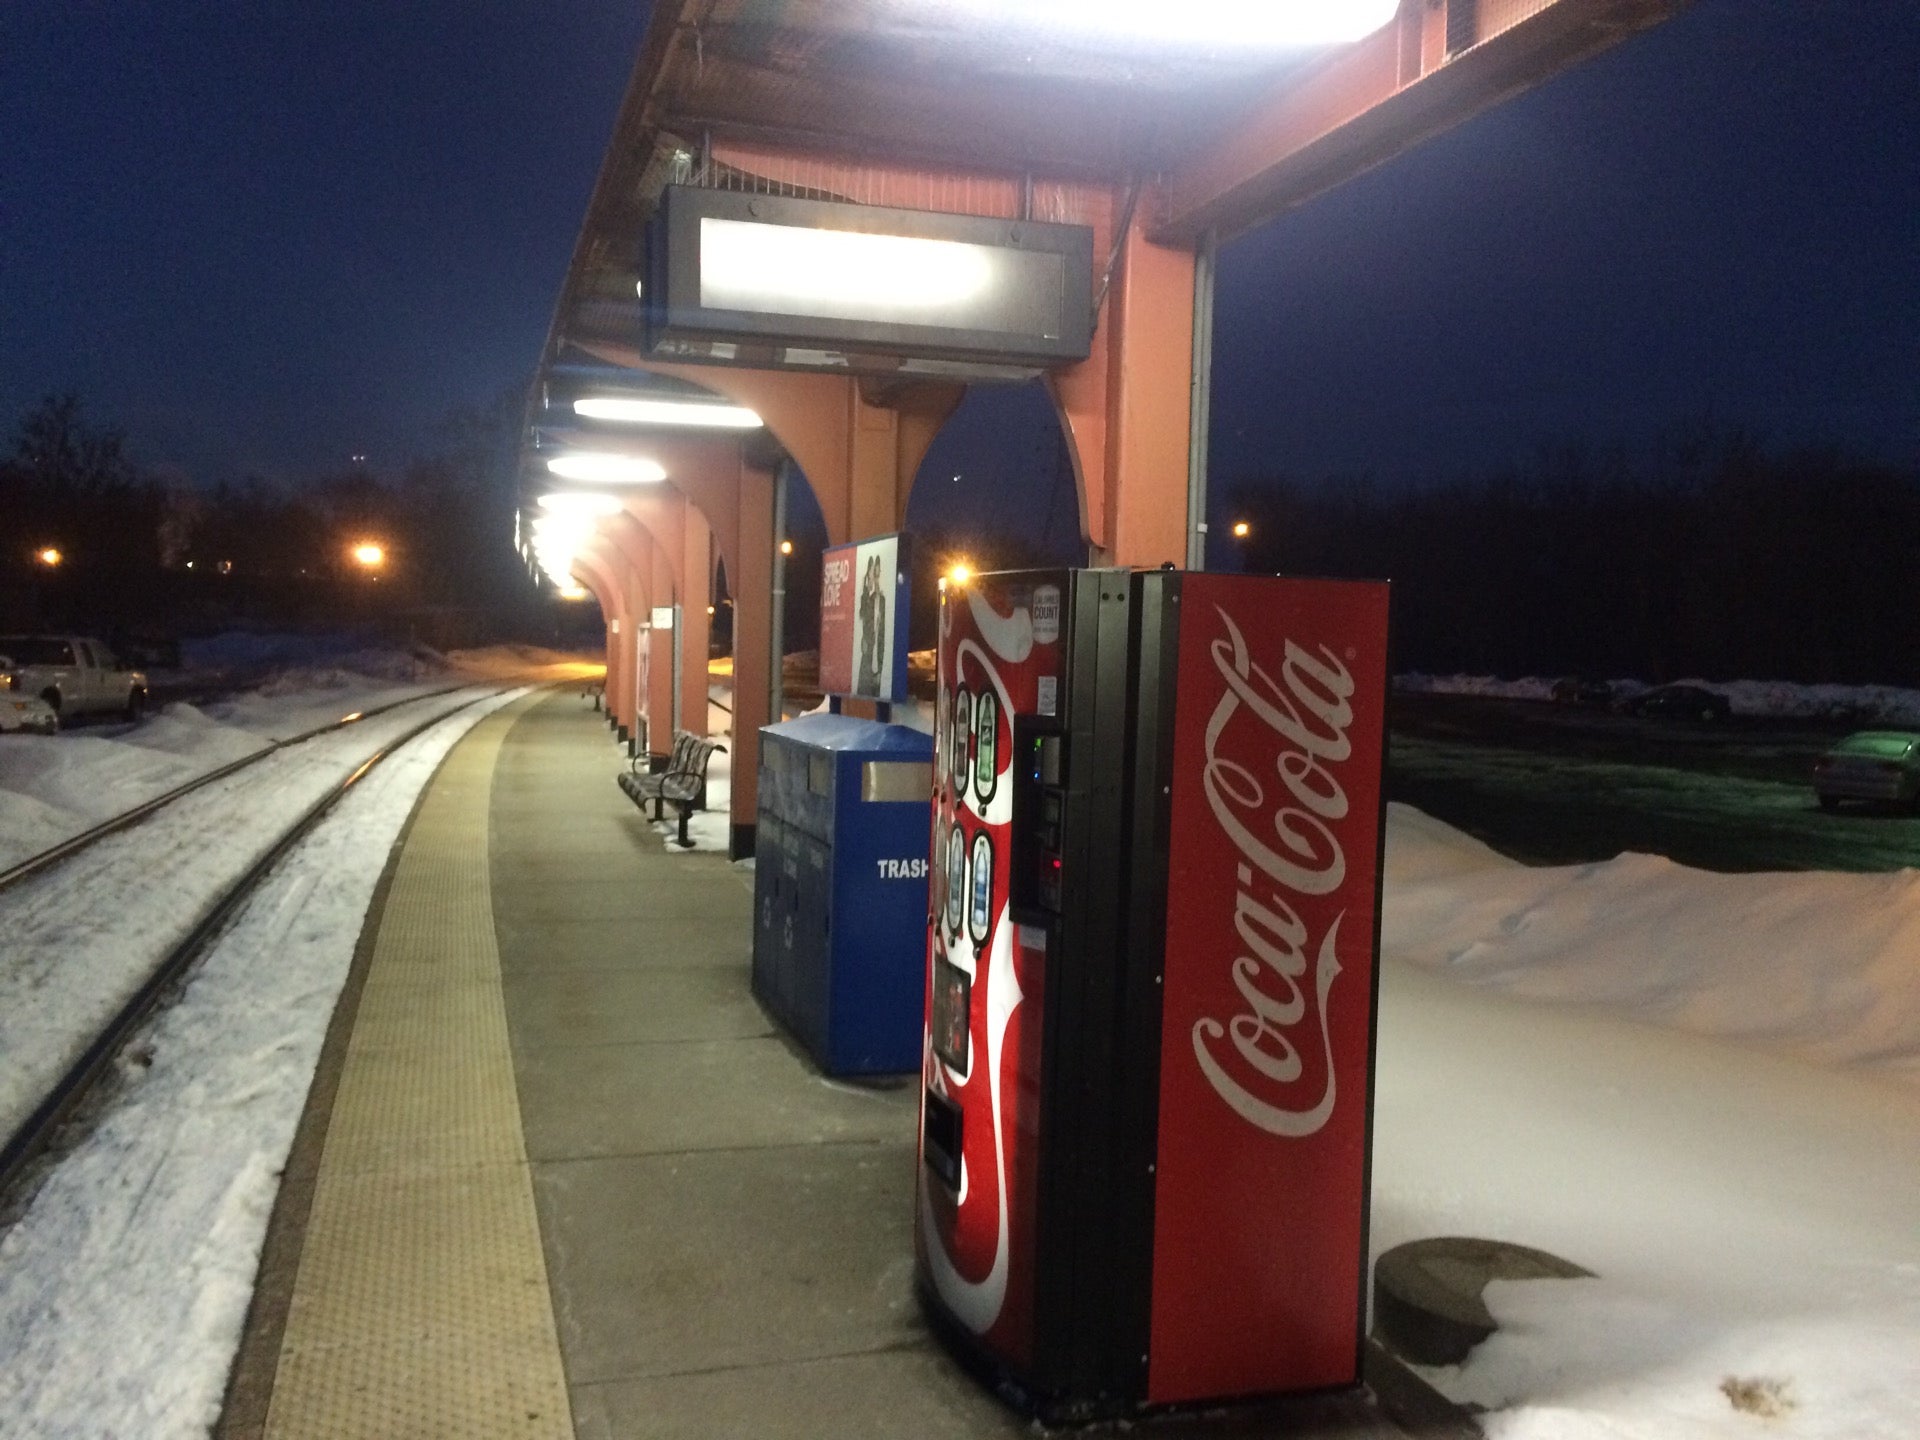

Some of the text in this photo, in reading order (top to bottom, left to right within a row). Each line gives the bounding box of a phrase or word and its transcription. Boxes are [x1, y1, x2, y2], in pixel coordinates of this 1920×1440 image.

[823, 584, 841, 607] LOVE
[1034, 606, 1058, 620] COUNT
[1192, 603, 1355, 1137] Coca-Cola
